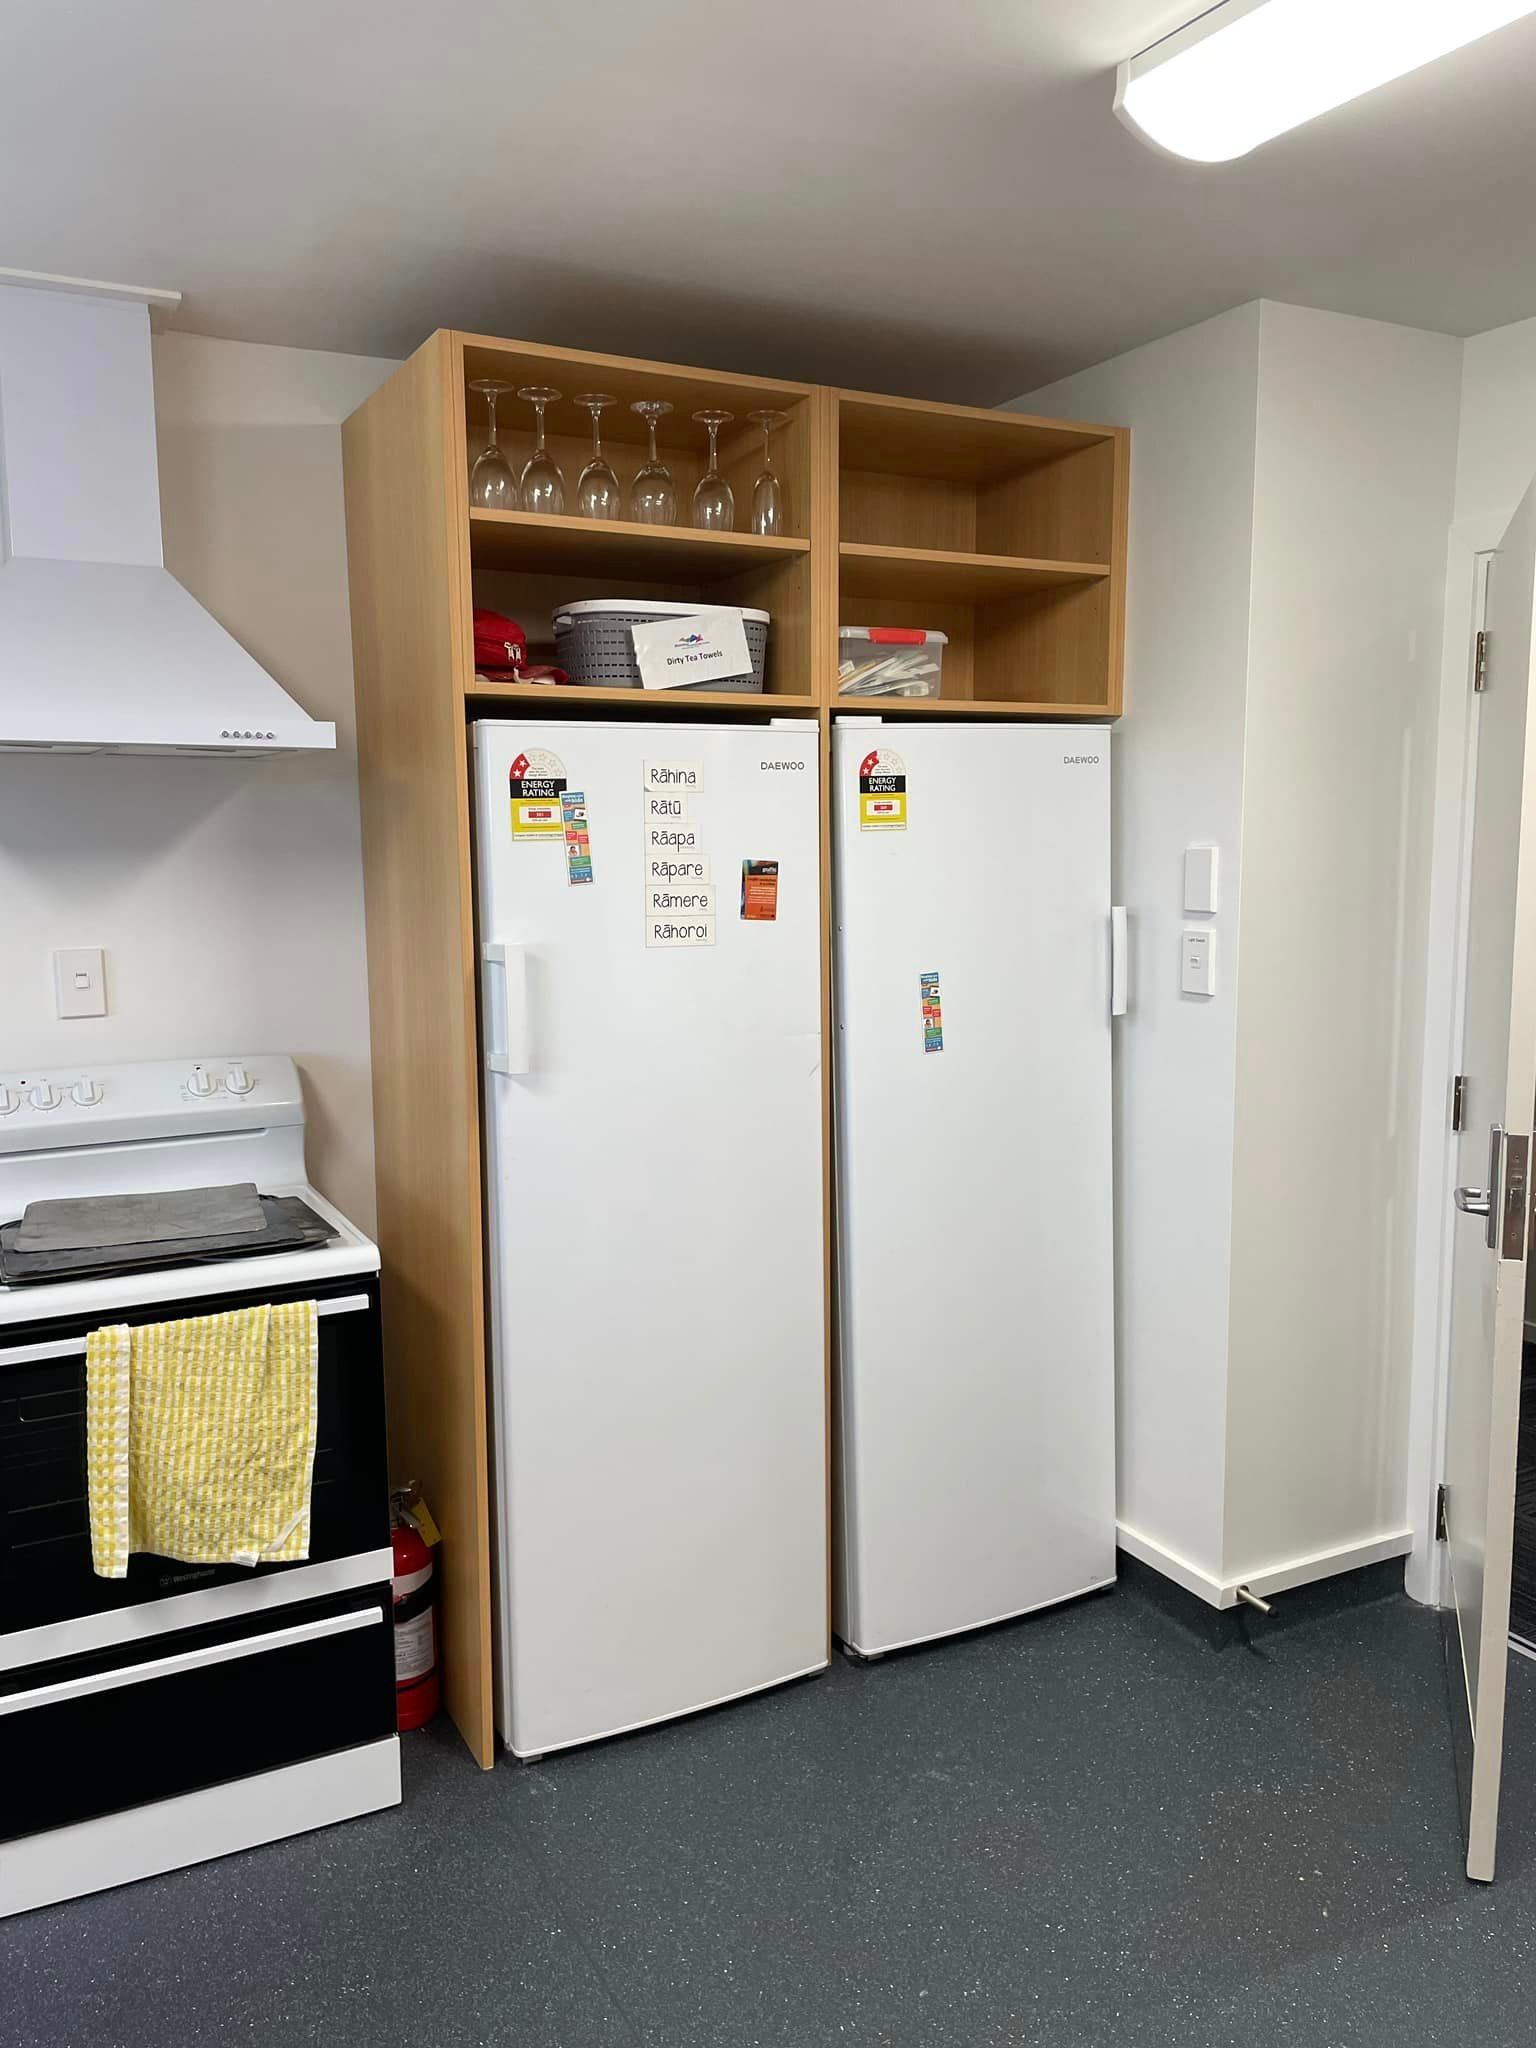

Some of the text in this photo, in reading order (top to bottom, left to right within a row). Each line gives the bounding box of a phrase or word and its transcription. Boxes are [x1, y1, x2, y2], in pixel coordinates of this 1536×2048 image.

[667, 656, 684, 666] Dirty
[699, 649, 723, 659] Towels
[761, 761, 805, 770] DAEWOO
[1063, 756, 1100, 764] DAEWOO
[651, 768, 697, 784] Rāhina
[869, 777, 896, 785] ENERGY
[521, 780, 555, 789] ENERGY
[522, 788, 555, 797] RATING
[651, 800, 681, 815] Rātū
[651, 830, 695, 852] Rāapa
[652, 861, 704, 883] Rāpare
[653, 893, 708, 908] Rāmere
[654, 923, 708, 939] Rāhoroi
